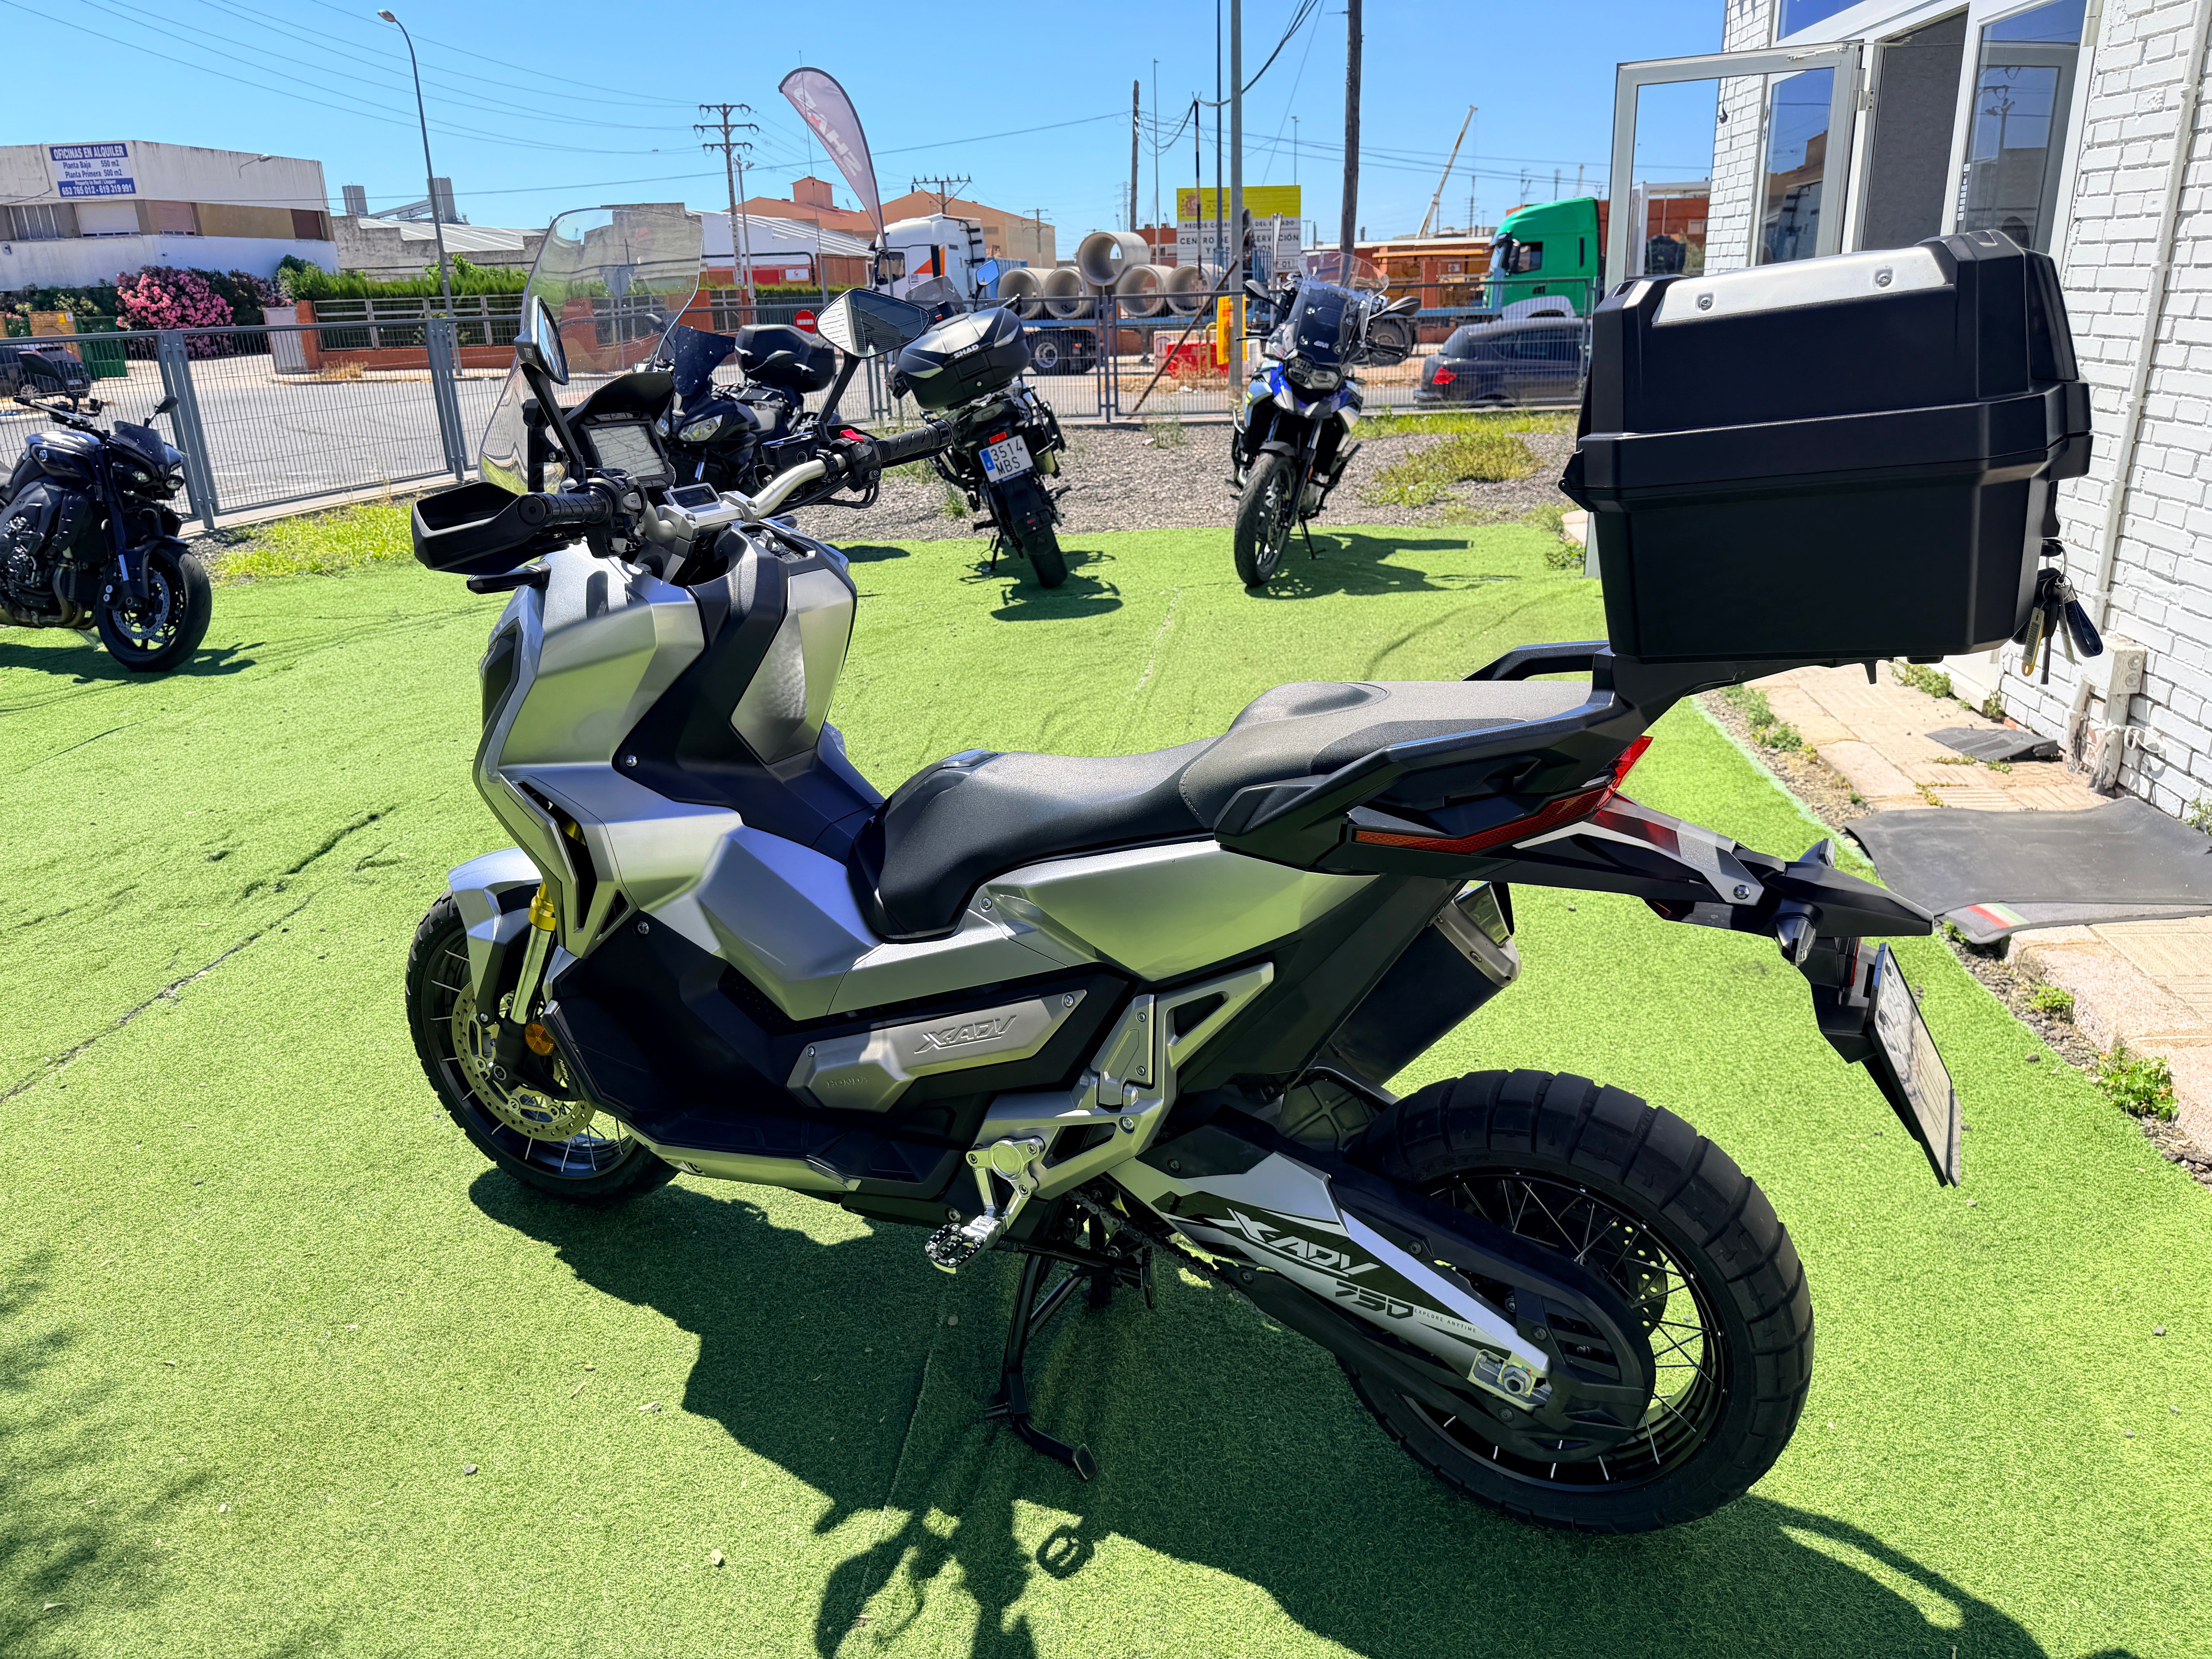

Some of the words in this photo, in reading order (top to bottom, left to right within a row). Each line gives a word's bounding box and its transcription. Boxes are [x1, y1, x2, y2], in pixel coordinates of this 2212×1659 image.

[53, 147, 82, 160] OFICINAS
[83, 147, 93, 158] EN
[93, 146, 124, 157] ALQUILER
[80, 161, 91, 169] Baja
[62, 187, 72, 195] 653
[73, 186, 83, 194] 765
[84, 185, 96, 194] 012
[99, 185, 110, 193] 619
[110, 184, 121, 193] 319
[122, 184, 132, 192] 991
[1180, 236, 1214, 245] CENRO
[953, 344, 979, 359] SHAD
[991, 439, 1023, 461] 3514
[995, 456, 1020, 476] MBS
[914, 1015, 1017, 1054] X-ADV
[827, 1076, 867, 1088] HONDA
[1204, 1207, 1381, 1276] X-ADV
[1335, 1280, 1414, 1319] 750
[1414, 1308, 1443, 1322] EXPLORE
[1447, 1319, 1476, 1333] ANYTIME
